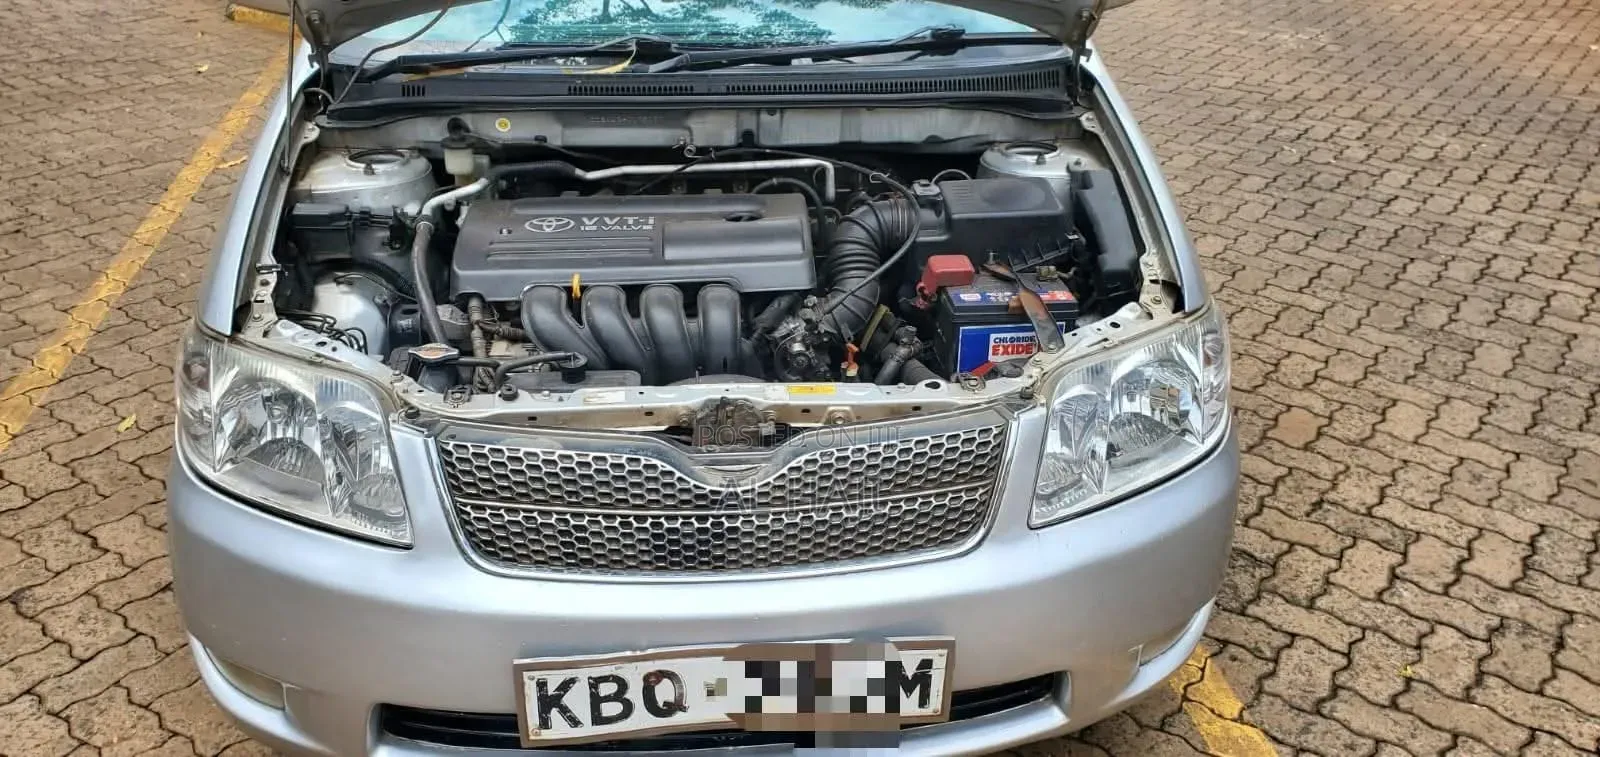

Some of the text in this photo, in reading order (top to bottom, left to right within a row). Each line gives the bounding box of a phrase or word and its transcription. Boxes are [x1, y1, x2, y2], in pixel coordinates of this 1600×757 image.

[993, 335, 1036, 344] CHLORIDE
[991, 343, 1033, 356] EXIDE
[536, 669, 689, 730] KBQ
